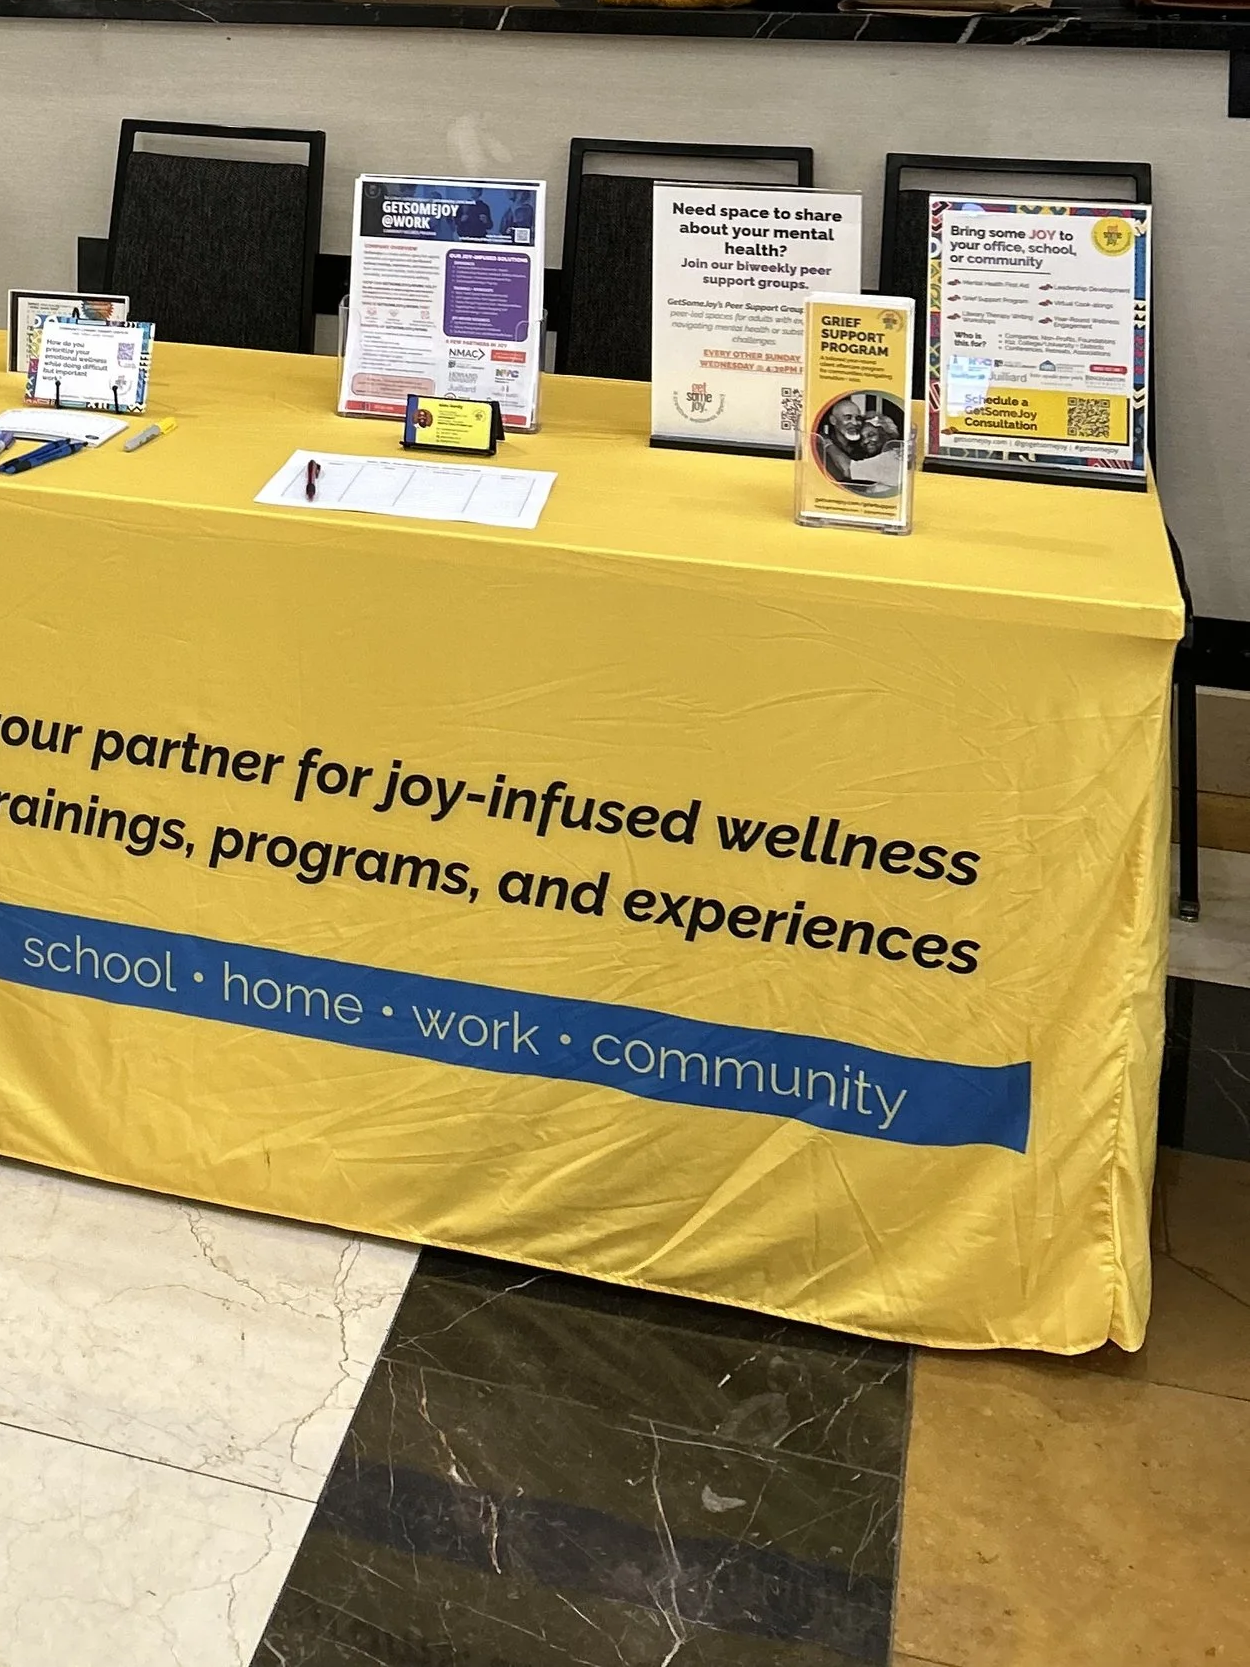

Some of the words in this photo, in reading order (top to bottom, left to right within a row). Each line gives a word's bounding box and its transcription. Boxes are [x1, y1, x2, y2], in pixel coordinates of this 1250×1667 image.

[382, 201, 459, 219] GETSOMEJOY
[673, 202, 716, 216] Need
[720, 207, 770, 219] space
[773, 208, 791, 219] to
[795, 209, 842, 222] share
[382, 215, 430, 229] @WORK
[679, 222, 728, 235] about
[732, 226, 770, 239] your
[773, 228, 835, 241] mental
[950, 225, 985, 239] Bring
[989, 229, 1026, 238] some
[1029, 231, 1056, 240] JOY
[1059, 231, 1073, 240] to
[725, 242, 788, 257] health?
[950, 241, 980, 251] your
[983, 241, 1025, 253] office,
[1028, 245, 1077, 256] school,
[681, 258, 708, 269] Join
[711, 261, 734, 270] our
[736, 261, 797, 276] biweekly
[800, 267, 832, 277] peer
[950, 254, 964, 262] or
[967, 255, 1043, 269] community
[703, 275, 755, 287] support
[758, 280, 809, 291] groups.
[745, 303, 778, 312] Support
[821, 316, 861, 328] GRIEF
[821, 329, 885, 343] SUPPORT
[954, 331, 974, 340] Who
[821, 342, 889, 357] PROGRAM
[954, 339, 970, 347] this
[971, 340, 987, 348] for?
[449, 348, 478, 358] NMAC
[704, 349, 732, 357] EVERY
[765, 353, 801, 361] SUNDAY
[700, 360, 754, 370] WEDNESDAY
[686, 392, 712, 403] some
[965, 394, 1018, 407] Schedule
[965, 406, 1037, 420] GetSomeJoy
[965, 418, 1038, 431] Consultation
[89, 727, 284, 784] partner
[294, 747, 373, 802] for
[374, 760, 702, 844] joy-infused
[715, 814, 982, 886] wellness
[208, 822, 481, 904] programs,
[497, 871, 610, 917] and
[622, 889, 982, 975] experiences
[23, 935, 178, 993] school
[223, 961, 364, 1025] home
[412, 1010, 540, 1056] work
[591, 1033, 908, 1130] community
